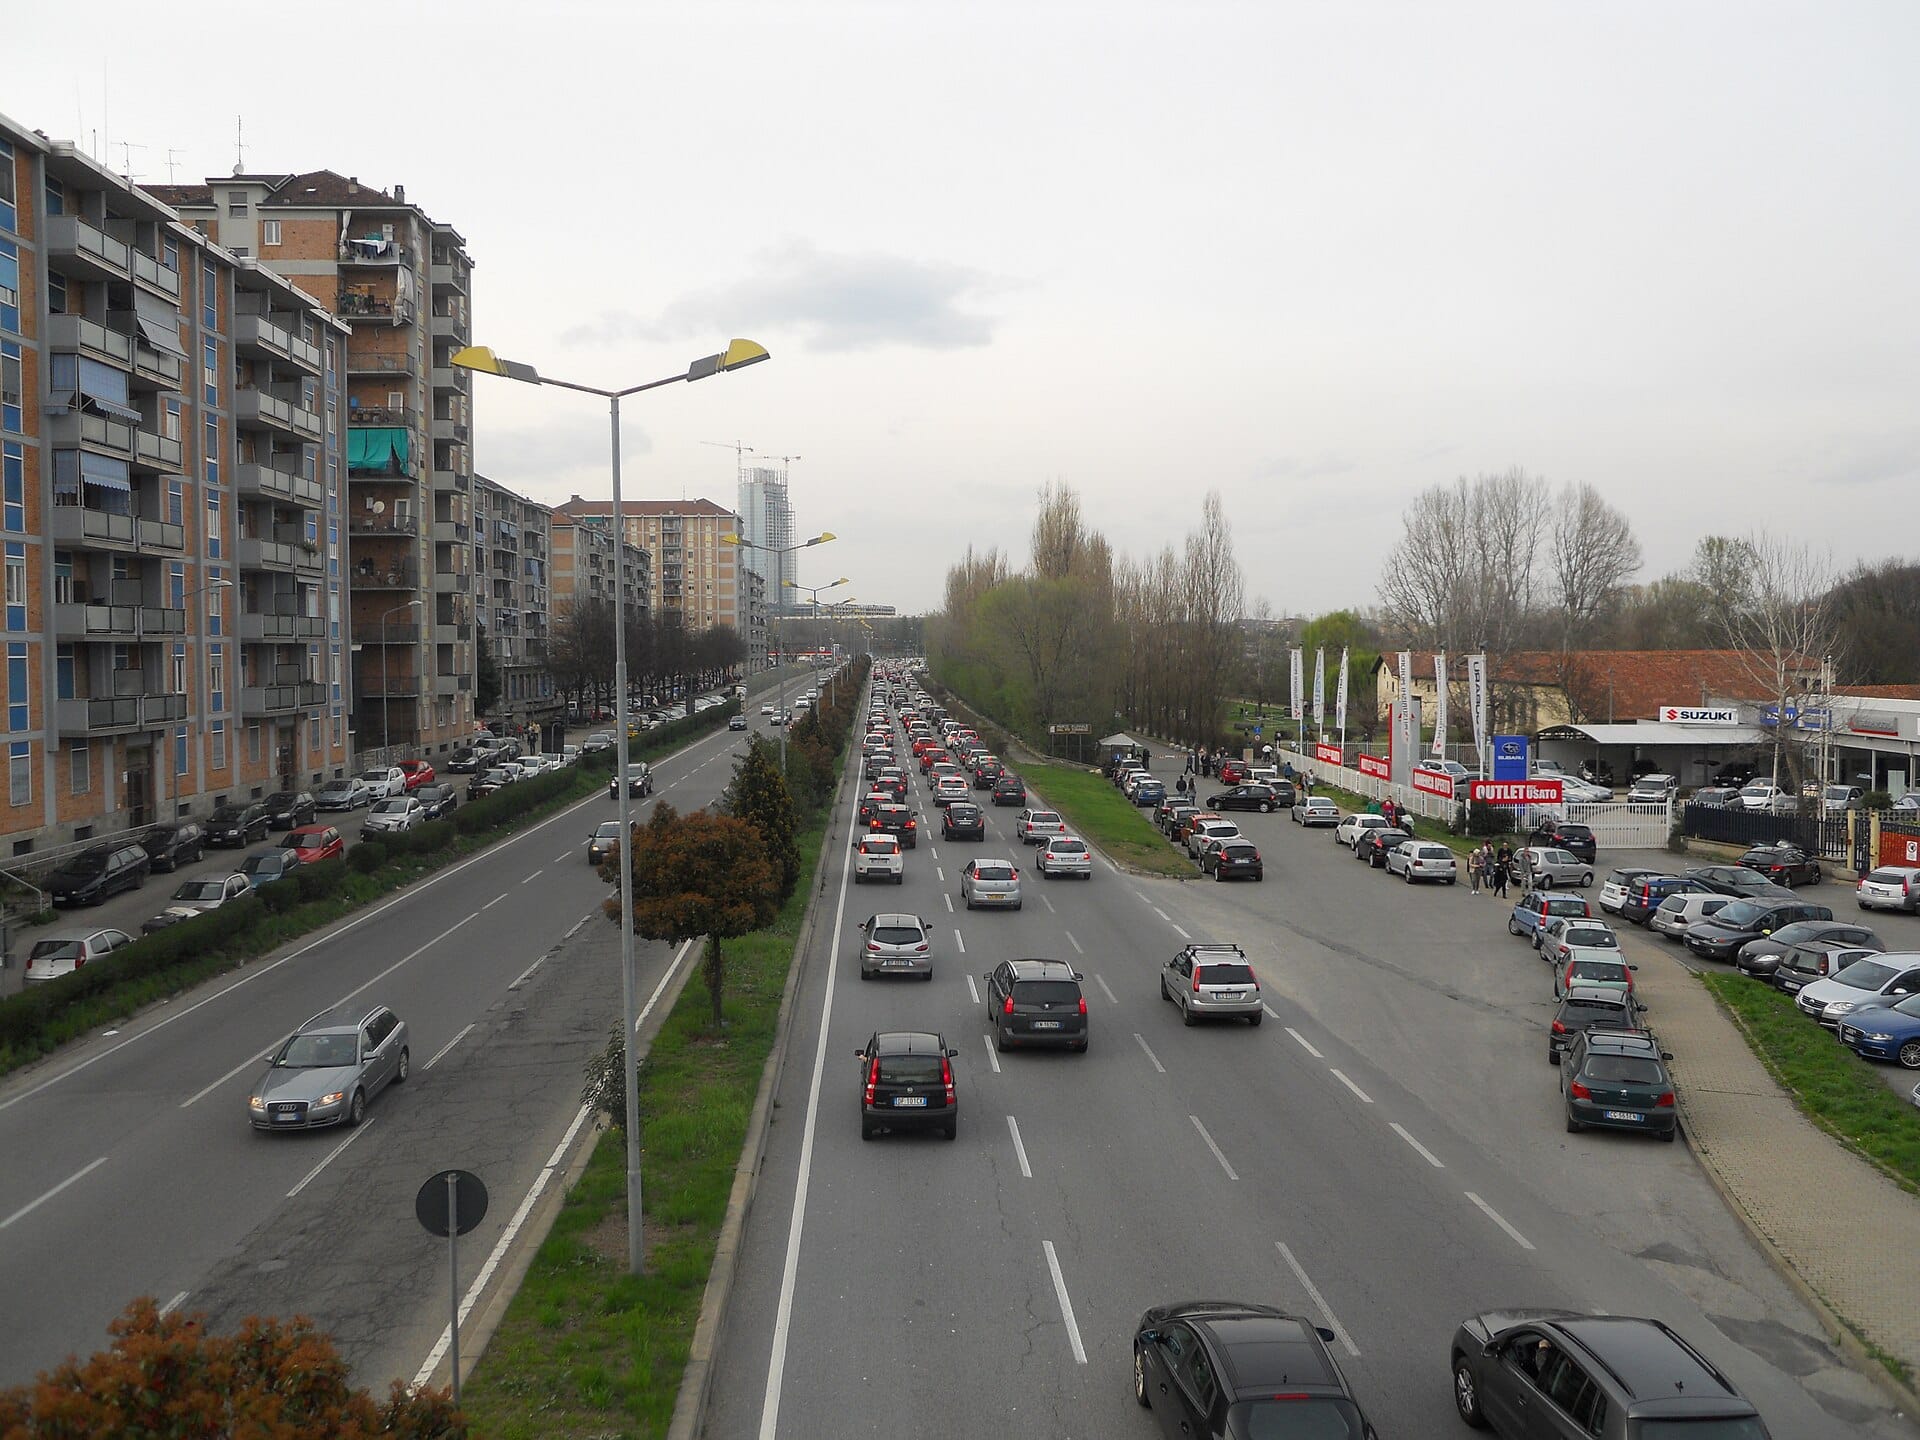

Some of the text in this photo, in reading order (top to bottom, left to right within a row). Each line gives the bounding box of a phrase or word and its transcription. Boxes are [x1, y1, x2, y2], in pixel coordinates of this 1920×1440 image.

[1680, 710, 1732, 720] SUZUKI
[1476, 784, 1557, 800] OUTLET USATO
